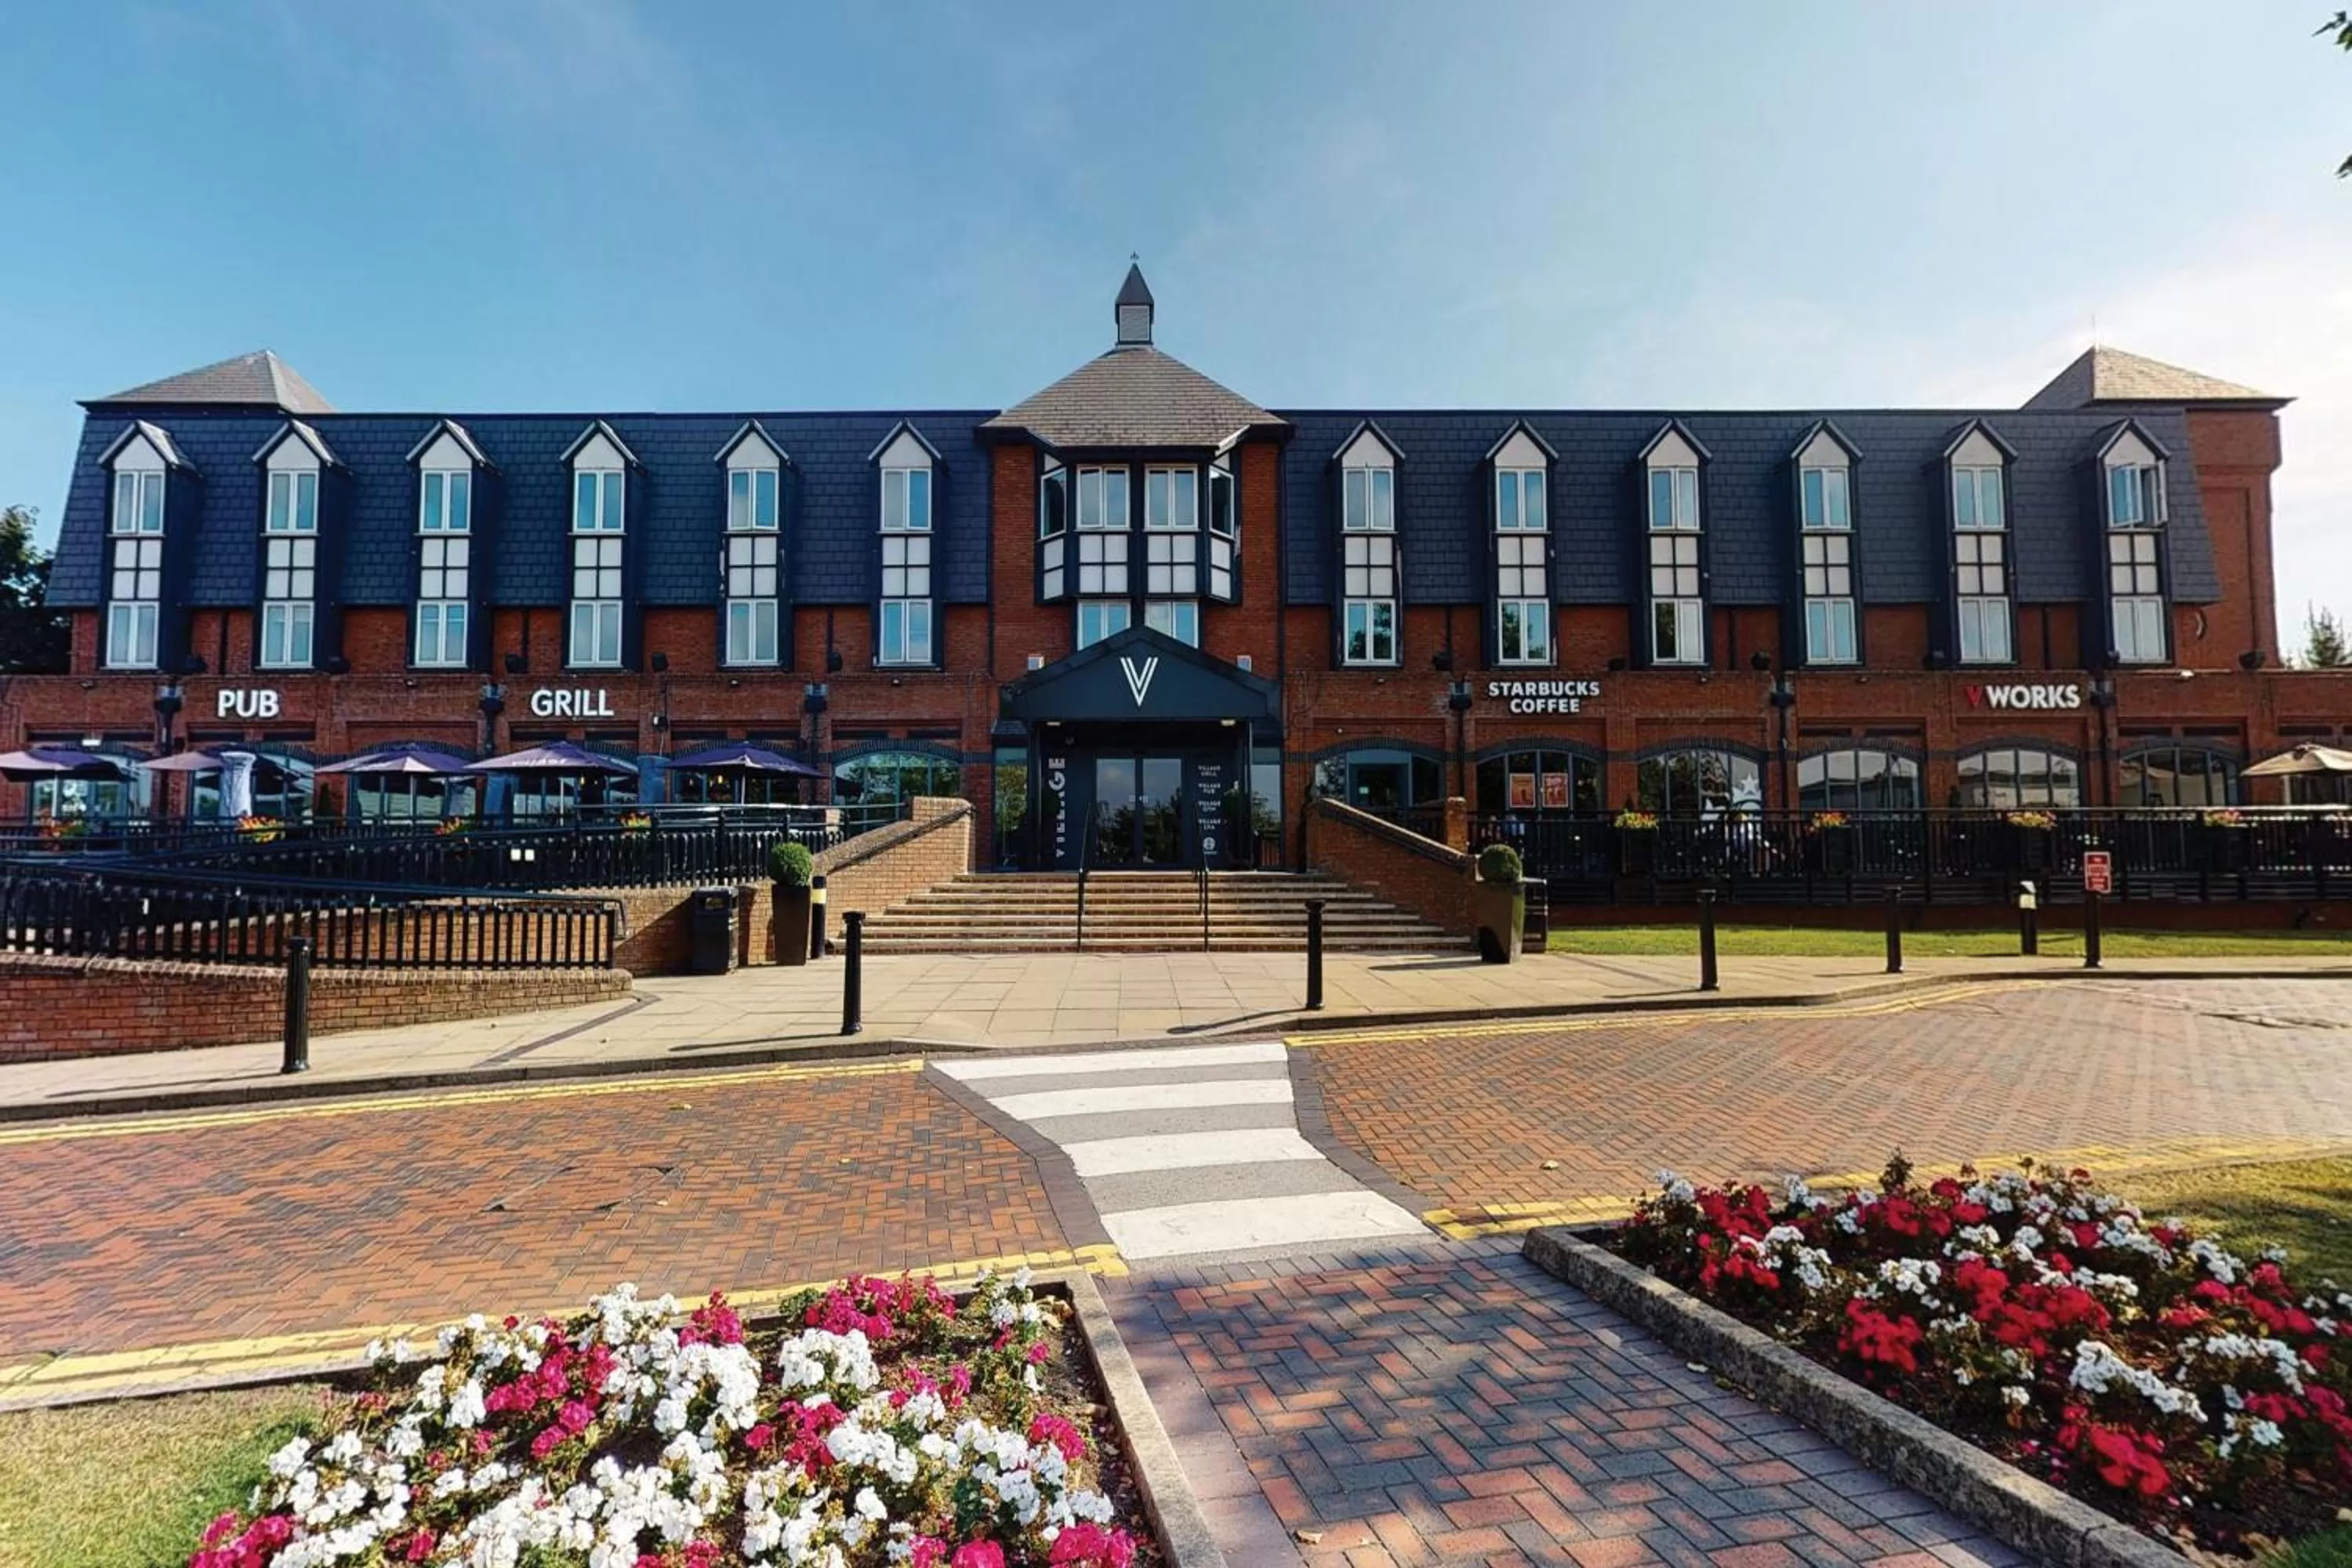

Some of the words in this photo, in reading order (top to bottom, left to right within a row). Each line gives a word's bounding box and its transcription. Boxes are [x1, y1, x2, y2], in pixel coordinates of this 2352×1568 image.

[1120, 656, 1159, 707] V
[1488, 681, 1600, 696] STARBUCKS
[218, 689, 279, 717] PUB
[531, 689, 615, 717] GRILL
[1509, 699, 1581, 713] COFFEE
[1985, 684, 2082, 709] WORKS
